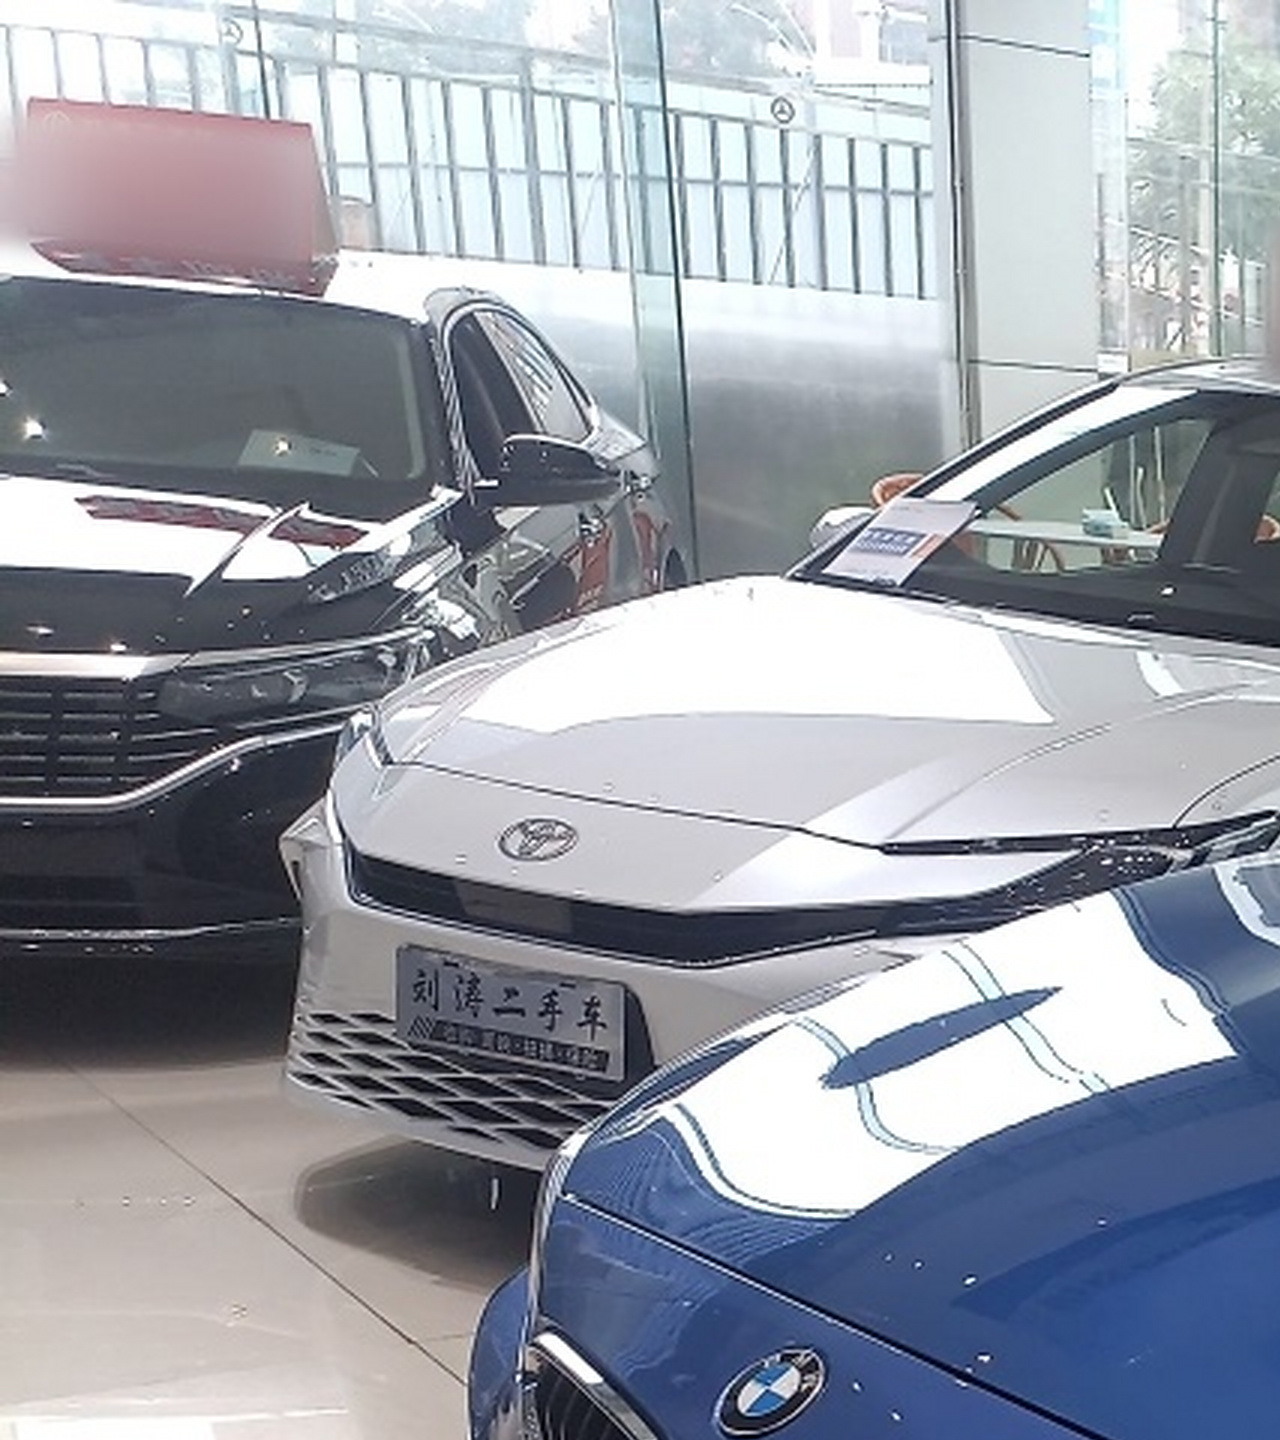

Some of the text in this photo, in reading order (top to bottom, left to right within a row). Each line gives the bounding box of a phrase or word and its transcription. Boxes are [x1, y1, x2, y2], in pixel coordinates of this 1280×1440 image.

[412, 967, 608, 1042] 刘涛二手车
